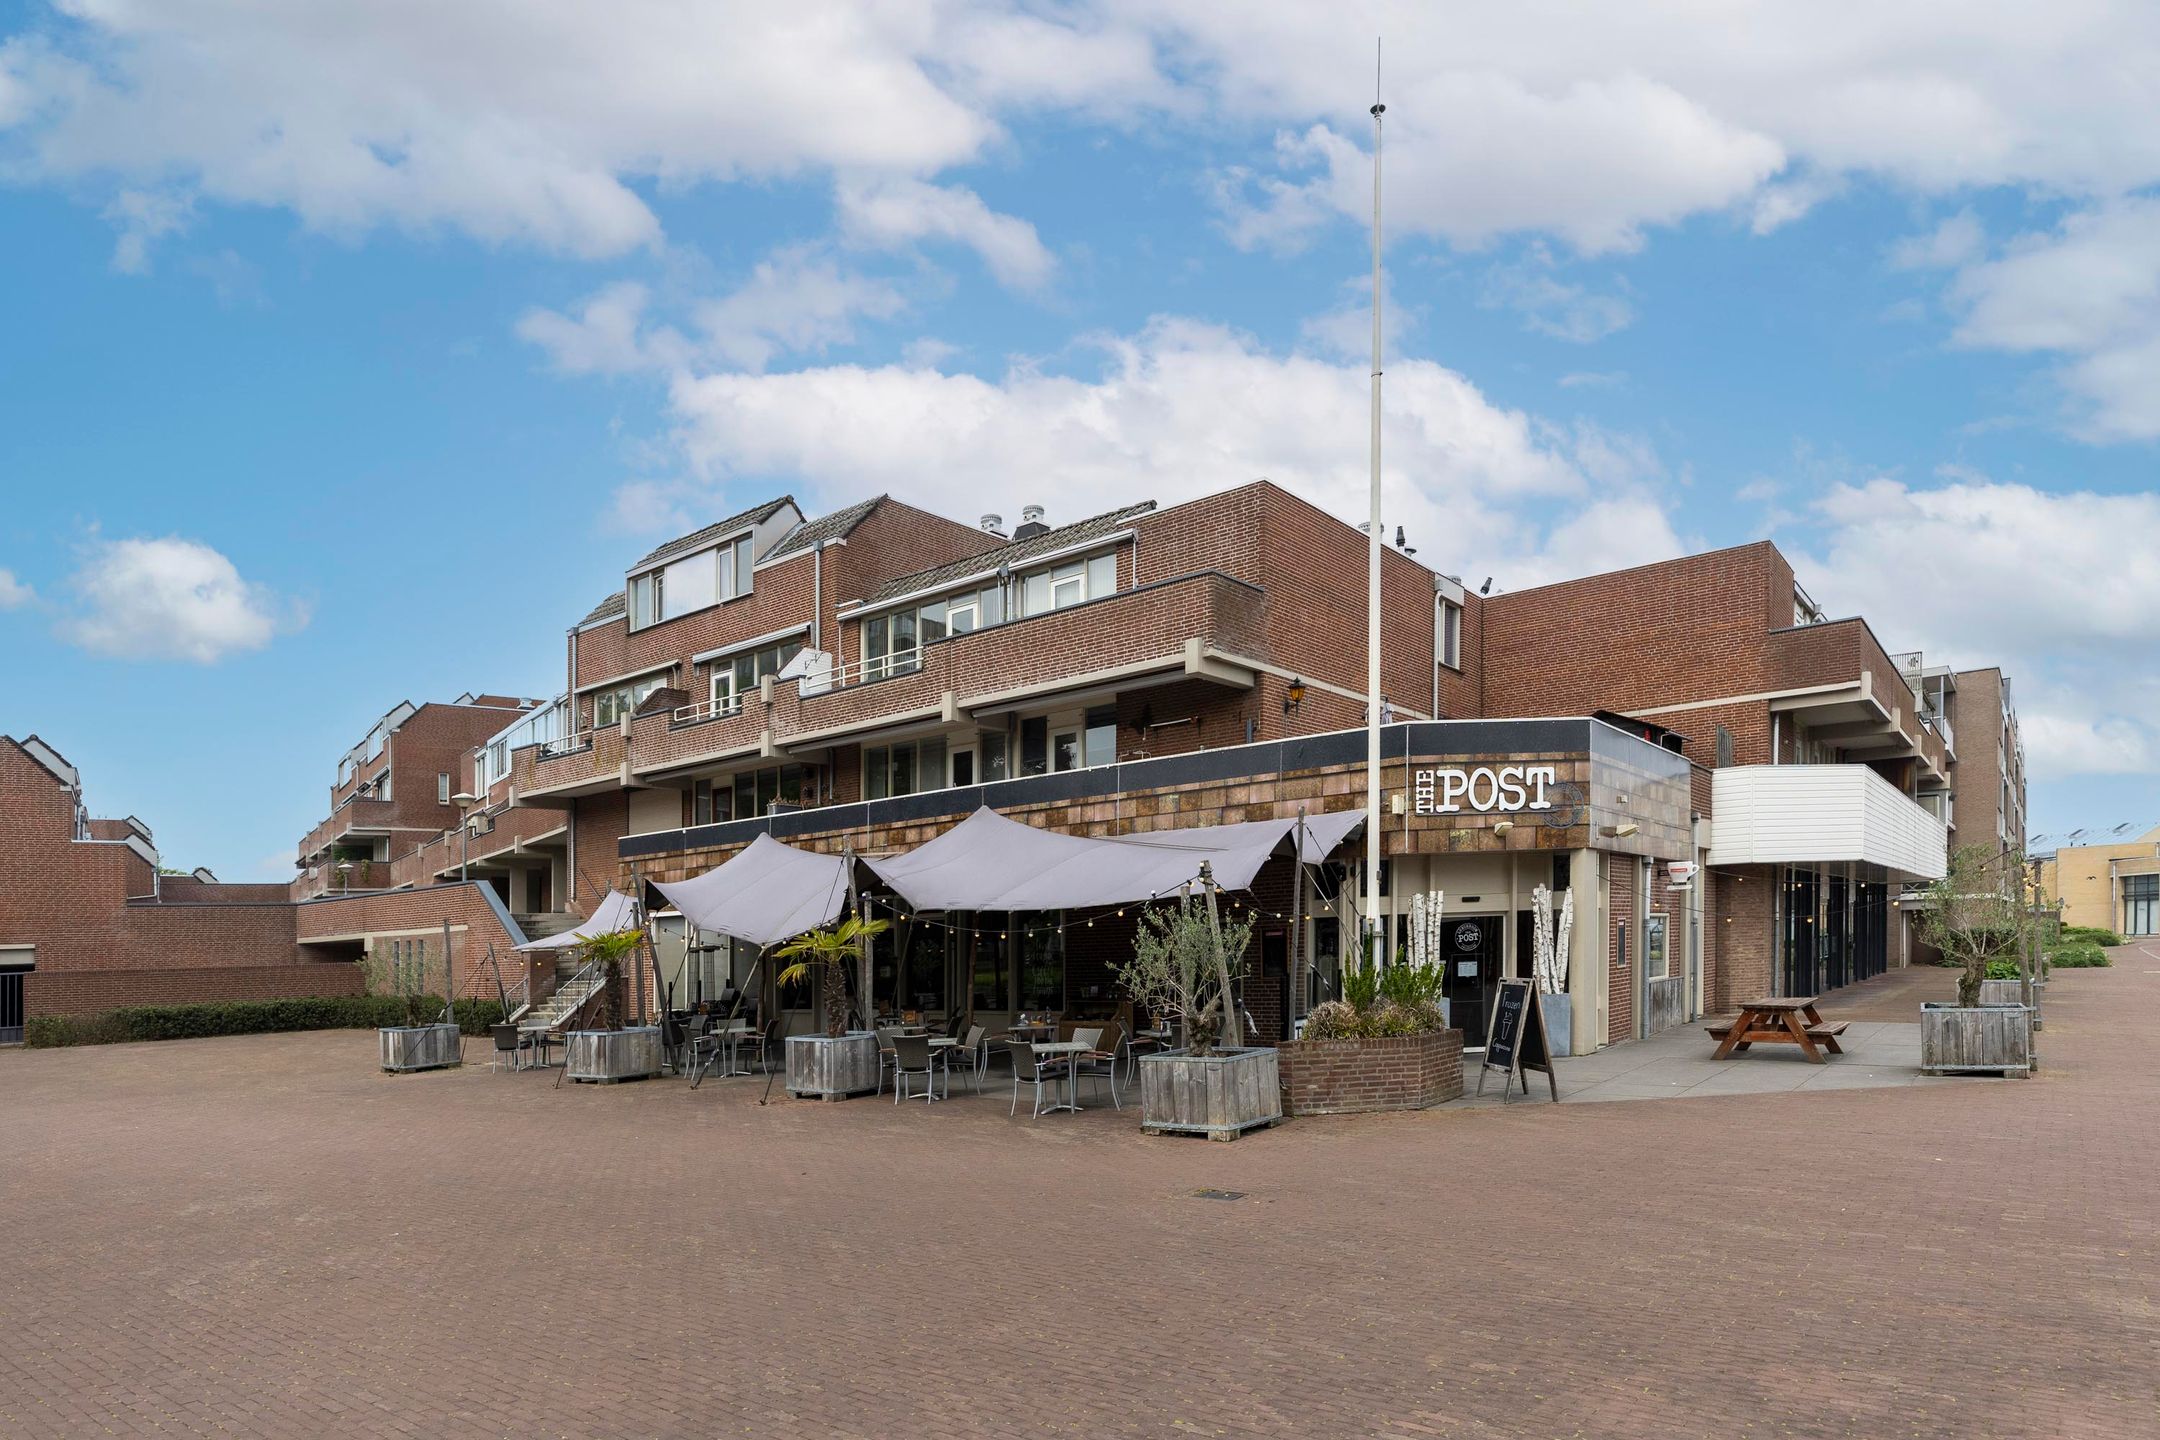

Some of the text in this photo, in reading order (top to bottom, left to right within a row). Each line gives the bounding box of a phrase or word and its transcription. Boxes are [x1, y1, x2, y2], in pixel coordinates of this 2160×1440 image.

[1415, 770, 1434, 814] THE
[1436, 766, 1555, 813] POST
[1458, 932, 1479, 942] POST
